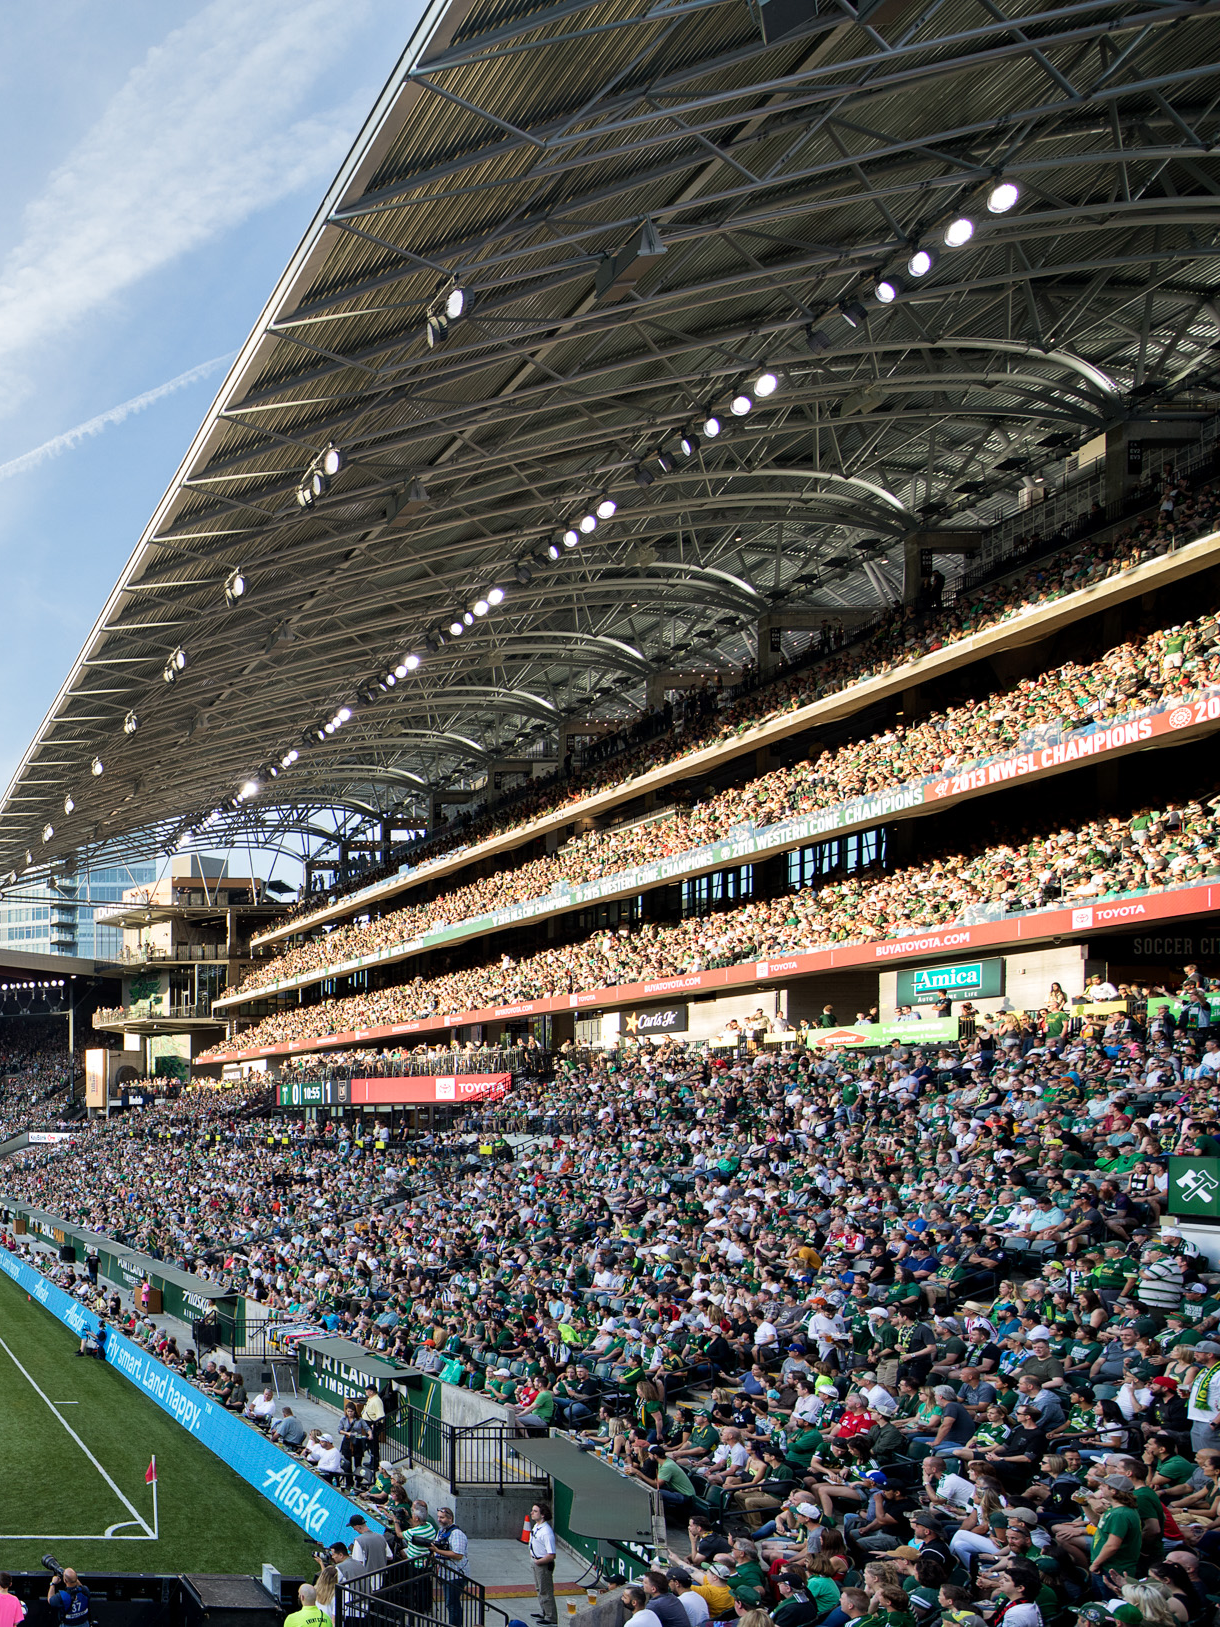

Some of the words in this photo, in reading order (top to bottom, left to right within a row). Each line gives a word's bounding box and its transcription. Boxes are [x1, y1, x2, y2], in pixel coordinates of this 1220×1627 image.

[950, 770, 986, 794] 2013
[988, 753, 1038, 782] NWSL
[1040, 718, 1152, 768] CHAMPIONS
[732, 837, 755, 857] 2018
[755, 823, 809, 851] WESTERN
[809, 814, 842, 834] CONF.
[844, 787, 924, 824] CHAMPIONS
[600, 874, 638, 896] WESTERN
[638, 868, 662, 886] CONF.
[661, 852, 714, 878] CHAMPIONS
[1095, 904, 1144, 920] TOYOTA
[876, 932, 970, 956] BUYATOYOTA.COM
[1134, 938, 1192, 954] SOCCER
[769, 962, 797, 974] TOYOTA
[644, 977, 700, 992] BUYATOYOTA.COM
[911, 967, 978, 990] Amica
[578, 994, 596, 1002] TOYOTA
[494, 1004, 533, 1016] BUYATOYOTA.COM
[638, 1012, 662, 1029] Carl's
[292, 1084, 299, 1105] 0
[304, 1087, 320, 1100] 10:55
[325, 1082, 331, 1103] 1
[458, 1082, 505, 1093] TOYOTA
[106, 1333, 120, 1364] Fly
[118, 1348, 142, 1381] smart.
[142, 1361, 168, 1400] Land
[166, 1378, 202, 1432] happy.
[262, 1464, 330, 1535] Alaska
[72, 1602, 81, 1612] 37
